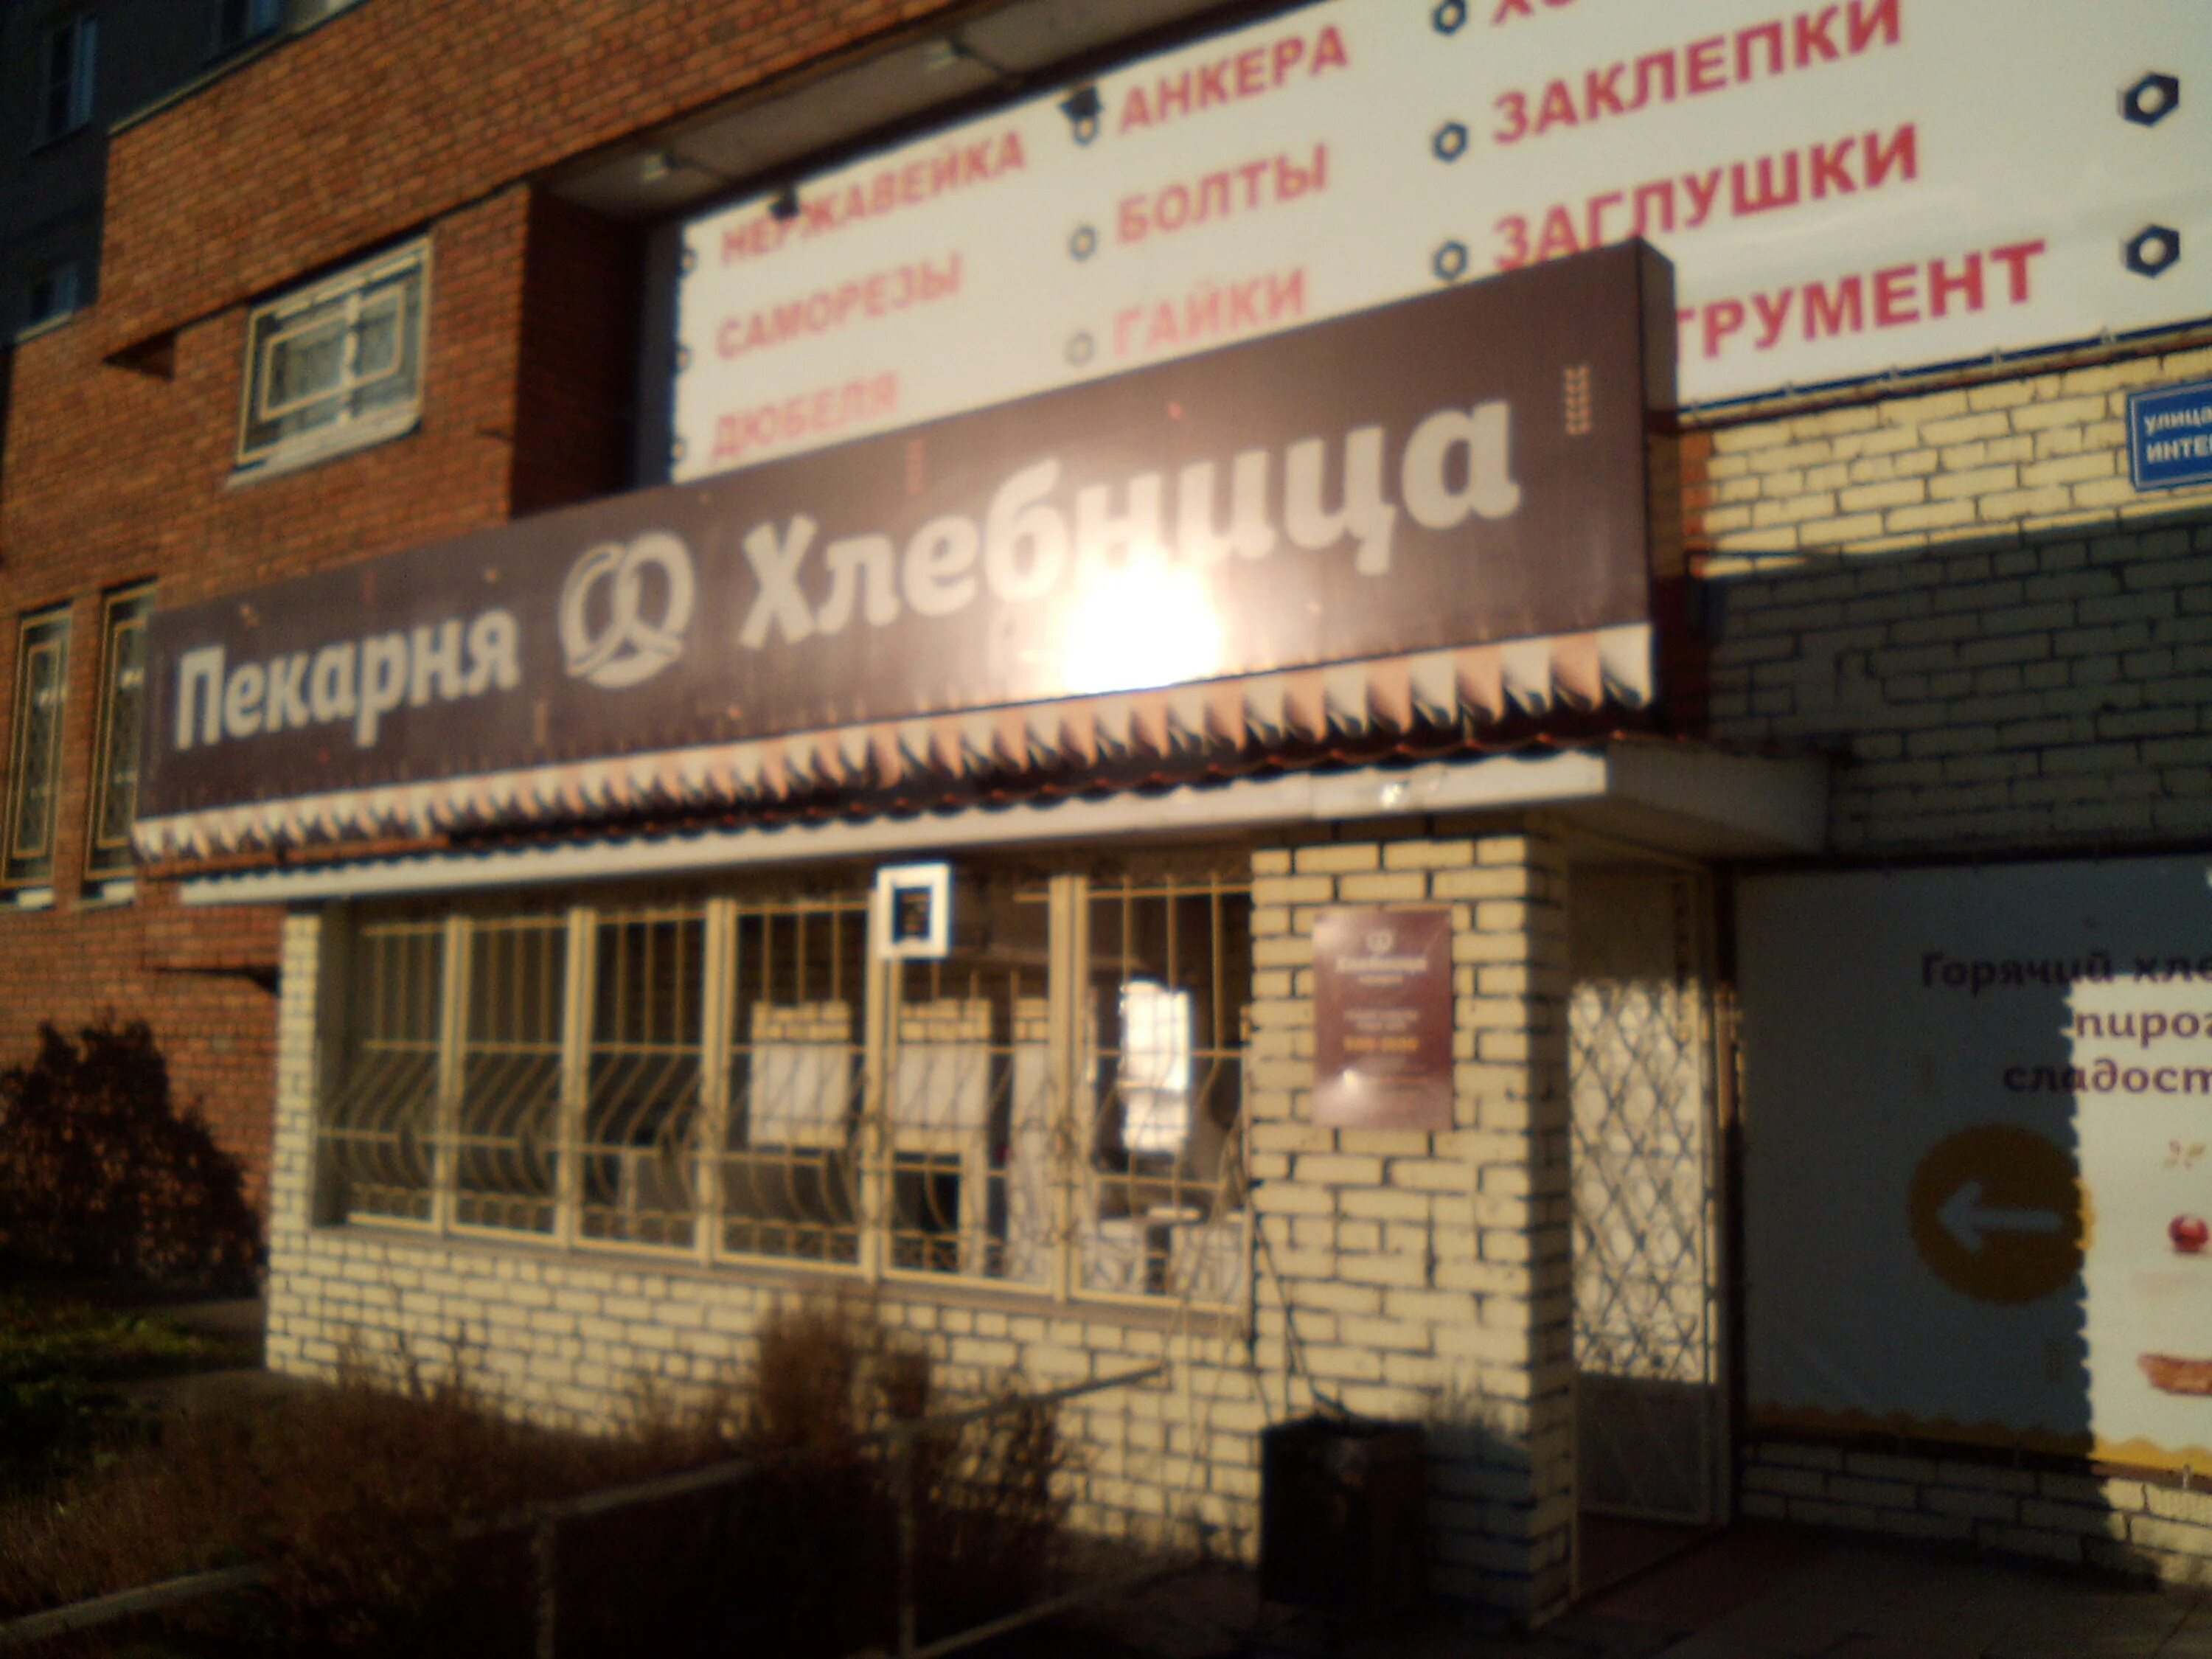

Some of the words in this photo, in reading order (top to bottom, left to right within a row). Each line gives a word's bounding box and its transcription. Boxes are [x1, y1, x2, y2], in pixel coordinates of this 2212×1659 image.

[1118, 24, 1349, 134] АНКЕРА
[1492, 0, 1902, 145] ЗАКЛЕПКИ
[1116, 142, 1329, 246] БОЛТЫ
[1492, 122, 1918, 273] ЗАГЛУШКИ
[715, 251, 964, 360] САМОРЕЗЫ
[1113, 268, 1307, 358] ГАЙКИ
[711, 372, 900, 463] ДЮБЕЛЯ
[2146, 434, 2212, 464] ИНТЕ
[175, 607, 522, 751] Пекарня
[738, 401, 1522, 650] Хлебница
[1921, 950, 2114, 998] Горячий
